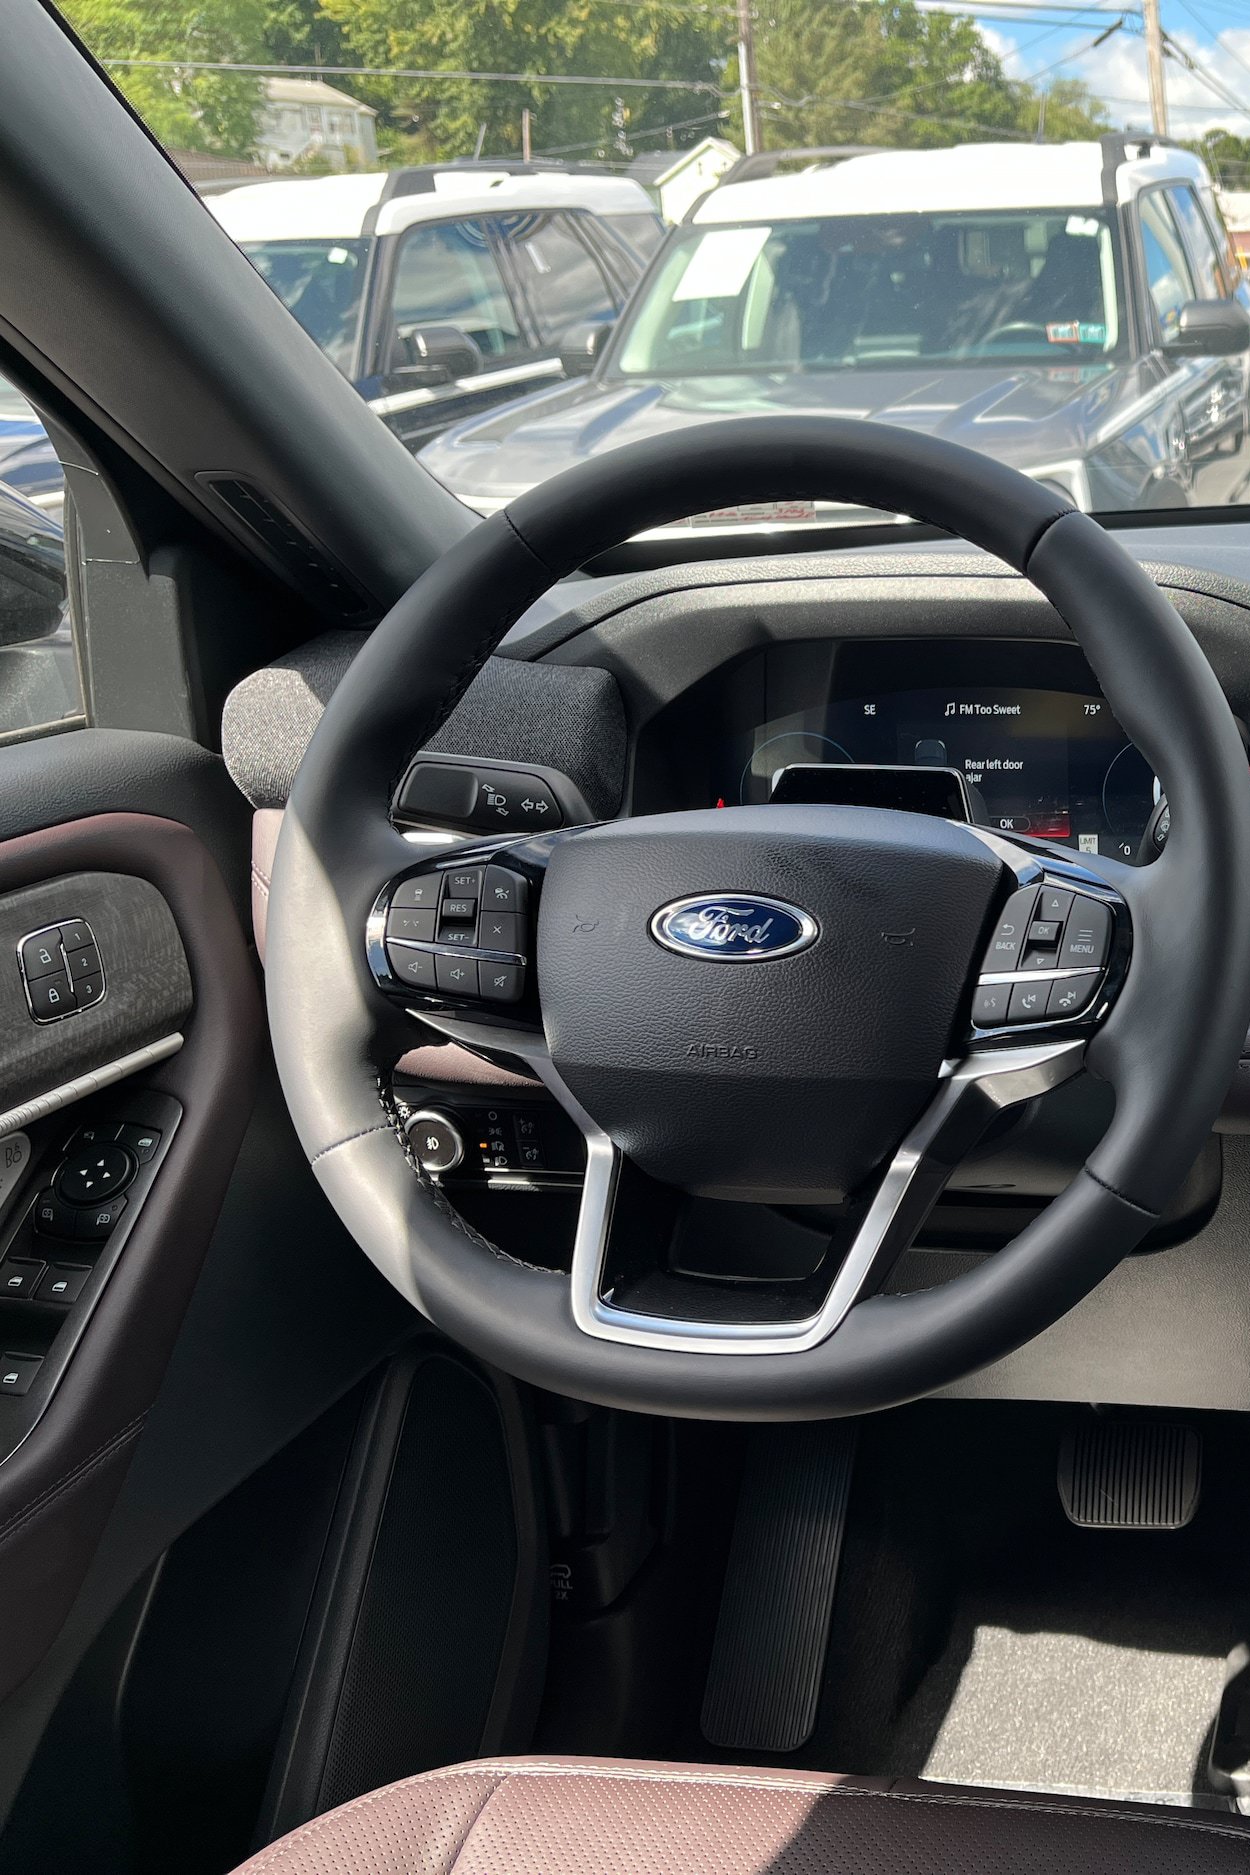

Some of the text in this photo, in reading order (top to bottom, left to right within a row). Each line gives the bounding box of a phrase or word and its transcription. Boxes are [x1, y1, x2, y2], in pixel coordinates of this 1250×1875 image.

[863, 704, 876, 716] SE
[959, 704, 1021, 715] FM Too Sweet
[965, 759, 1024, 770] Rear left door
[965, 773, 982, 784] ajar
[1000, 818, 1014, 829] OK
[449, 903, 467, 913] RES
[689, 905, 774, 945] Ford
[1037, 926, 1050, 935] OK
[995, 941, 1016, 951] BACK
[1069, 944, 1094, 954] MENU
[81, 957, 88, 967] 2
[86, 984, 93, 994] 3
[685, 1043, 759, 1060] AIRBAG
